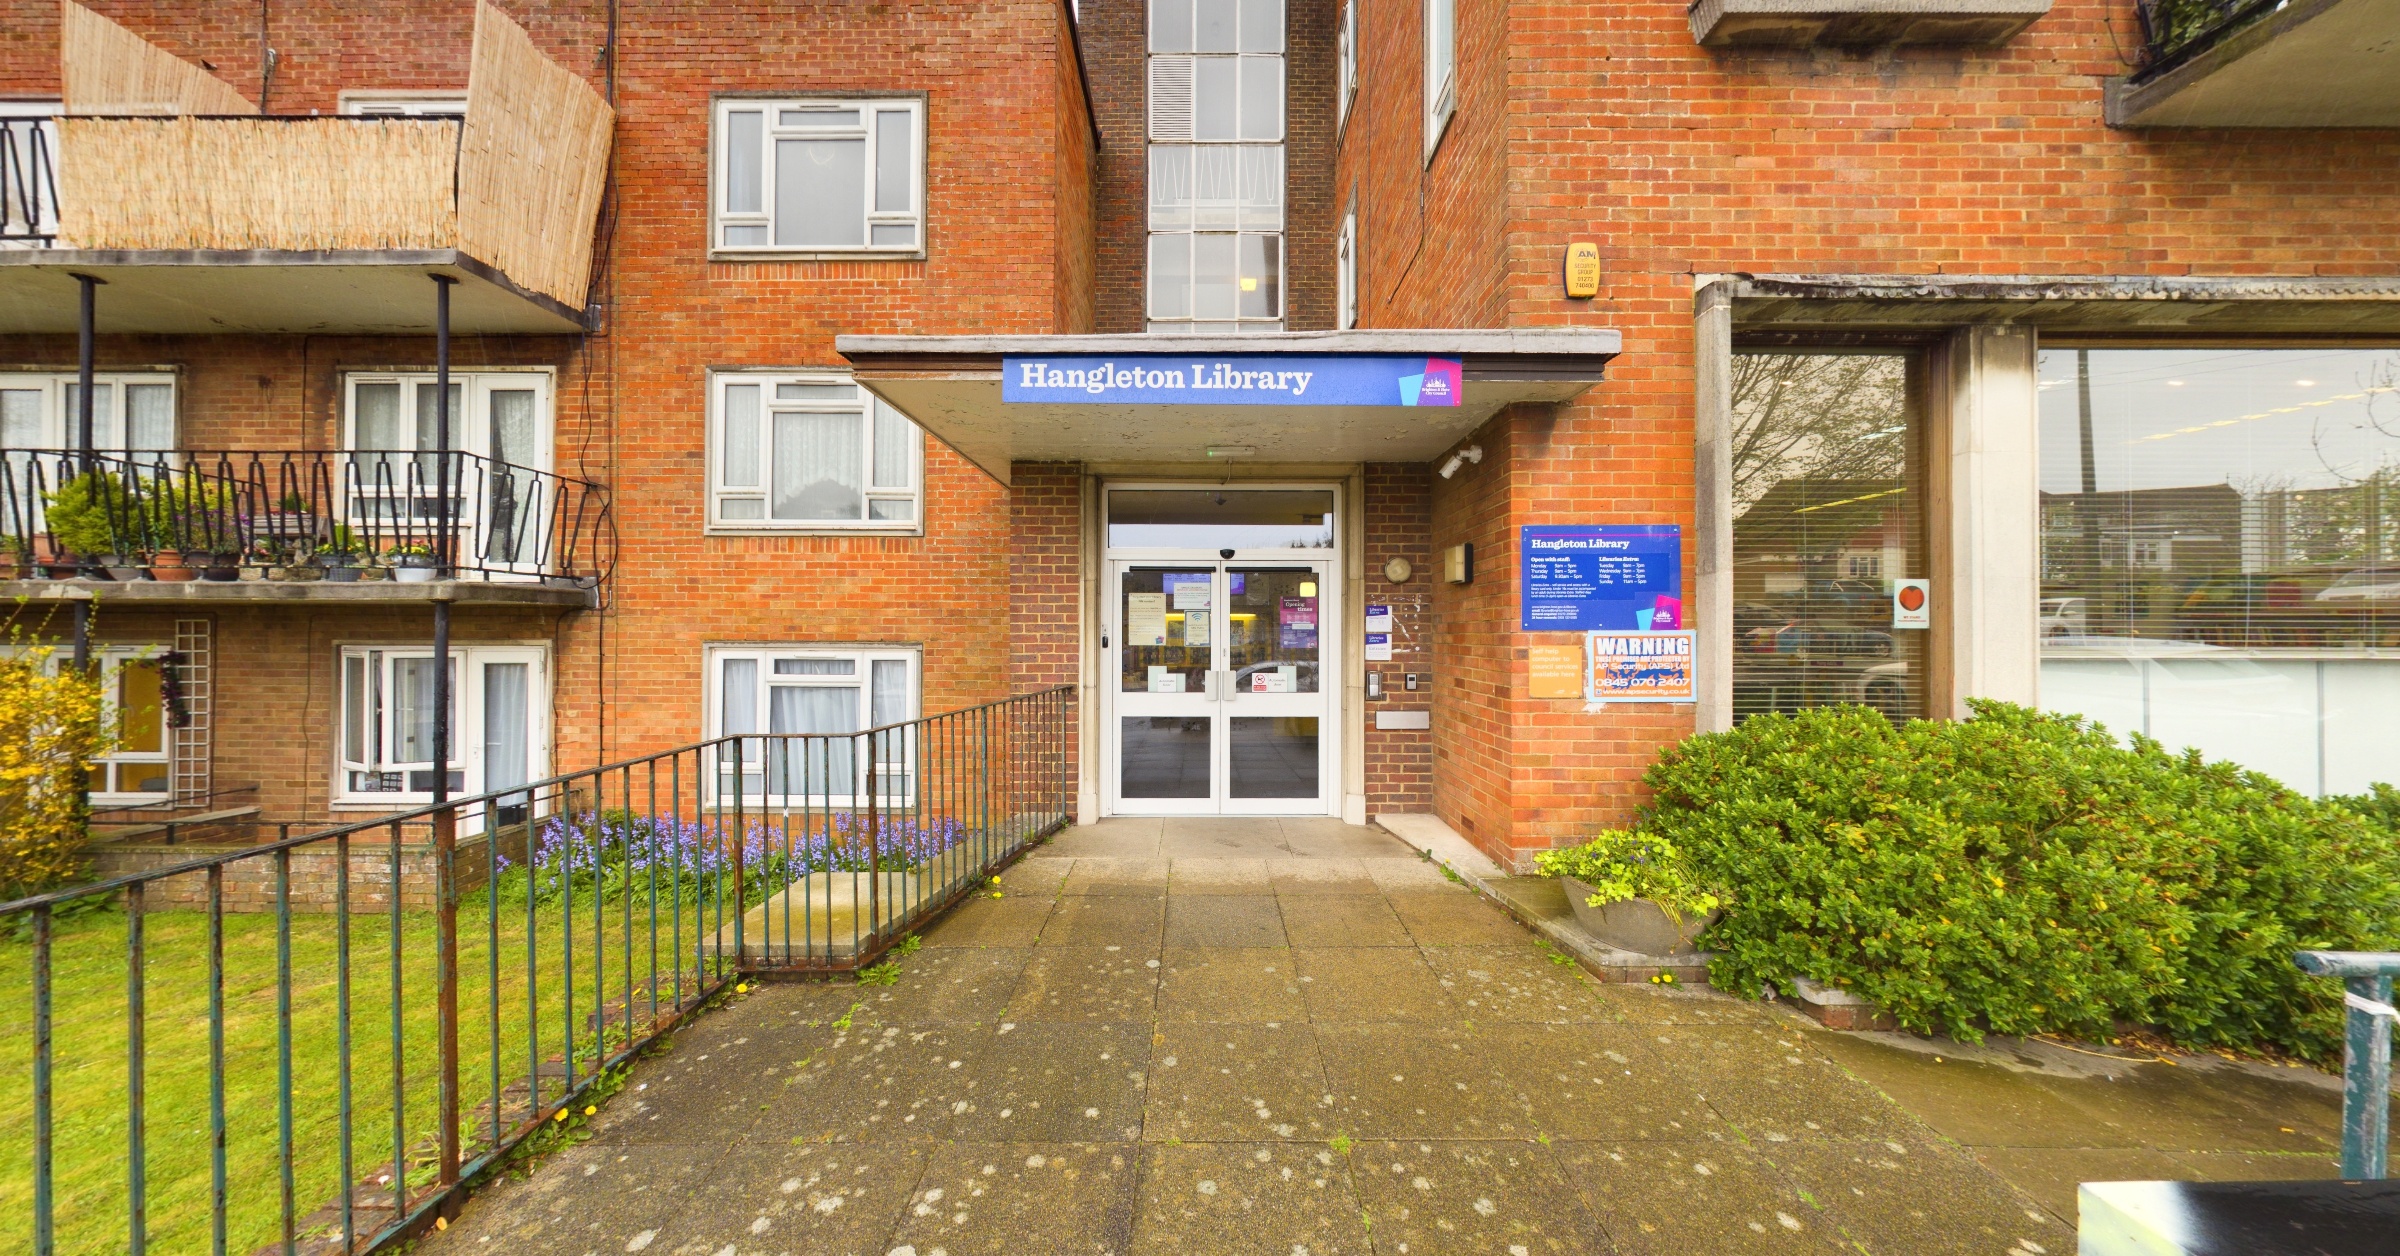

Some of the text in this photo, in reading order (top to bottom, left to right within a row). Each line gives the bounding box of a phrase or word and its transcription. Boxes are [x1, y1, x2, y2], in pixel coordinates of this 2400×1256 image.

[1020, 363, 1313, 395] Hangleton Library
[1532, 539, 1630, 550] Hangleton Library
[1596, 638, 1689, 655] WARNING
